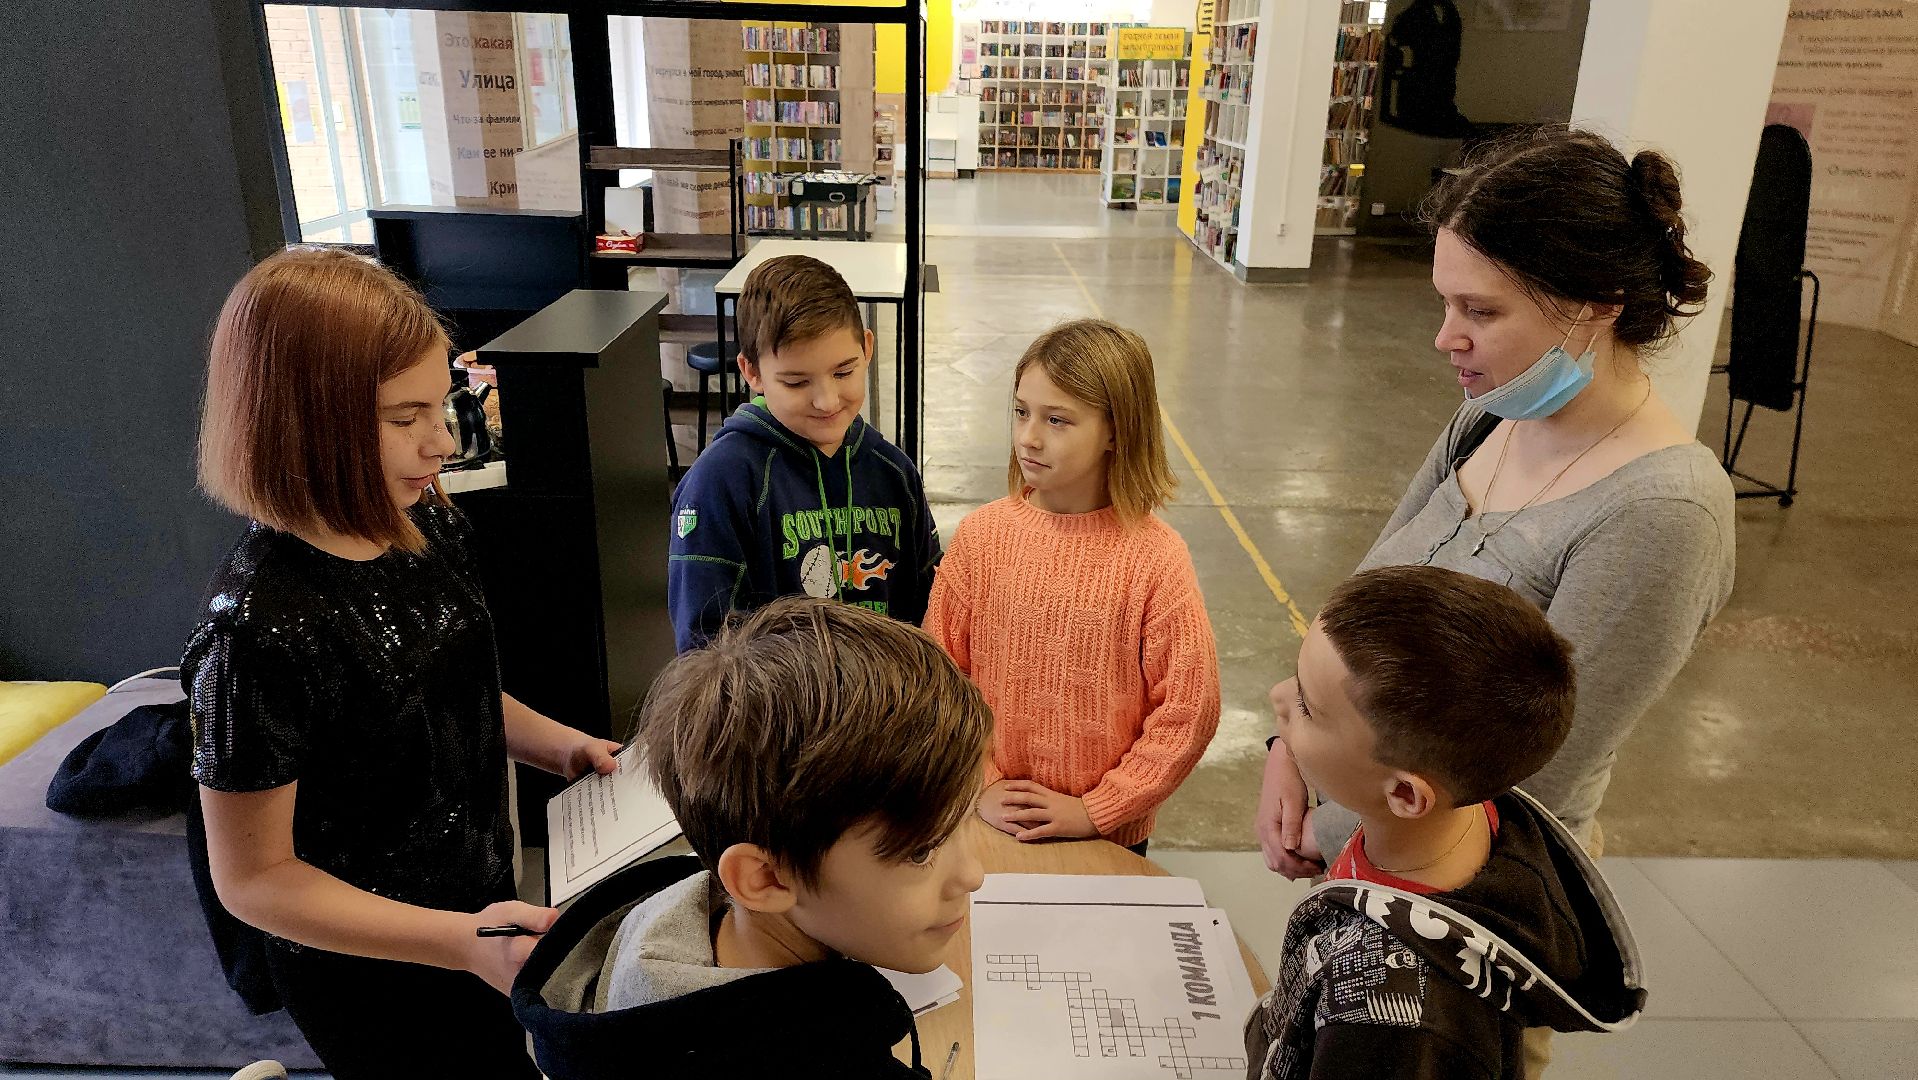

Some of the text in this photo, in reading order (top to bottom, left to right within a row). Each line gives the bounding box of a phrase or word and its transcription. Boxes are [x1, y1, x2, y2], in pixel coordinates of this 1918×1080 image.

[444, 33, 513, 50] Это какая
[458, 69, 515, 92] Улица
[453, 114, 472, 125] Что
[473, 116, 484, 125] за
[483, 147, 497, 159] ее
[782, 507, 901, 560] SOUTHPORT
[1168, 922, 1221, 1020] 1 КОМАНДА
